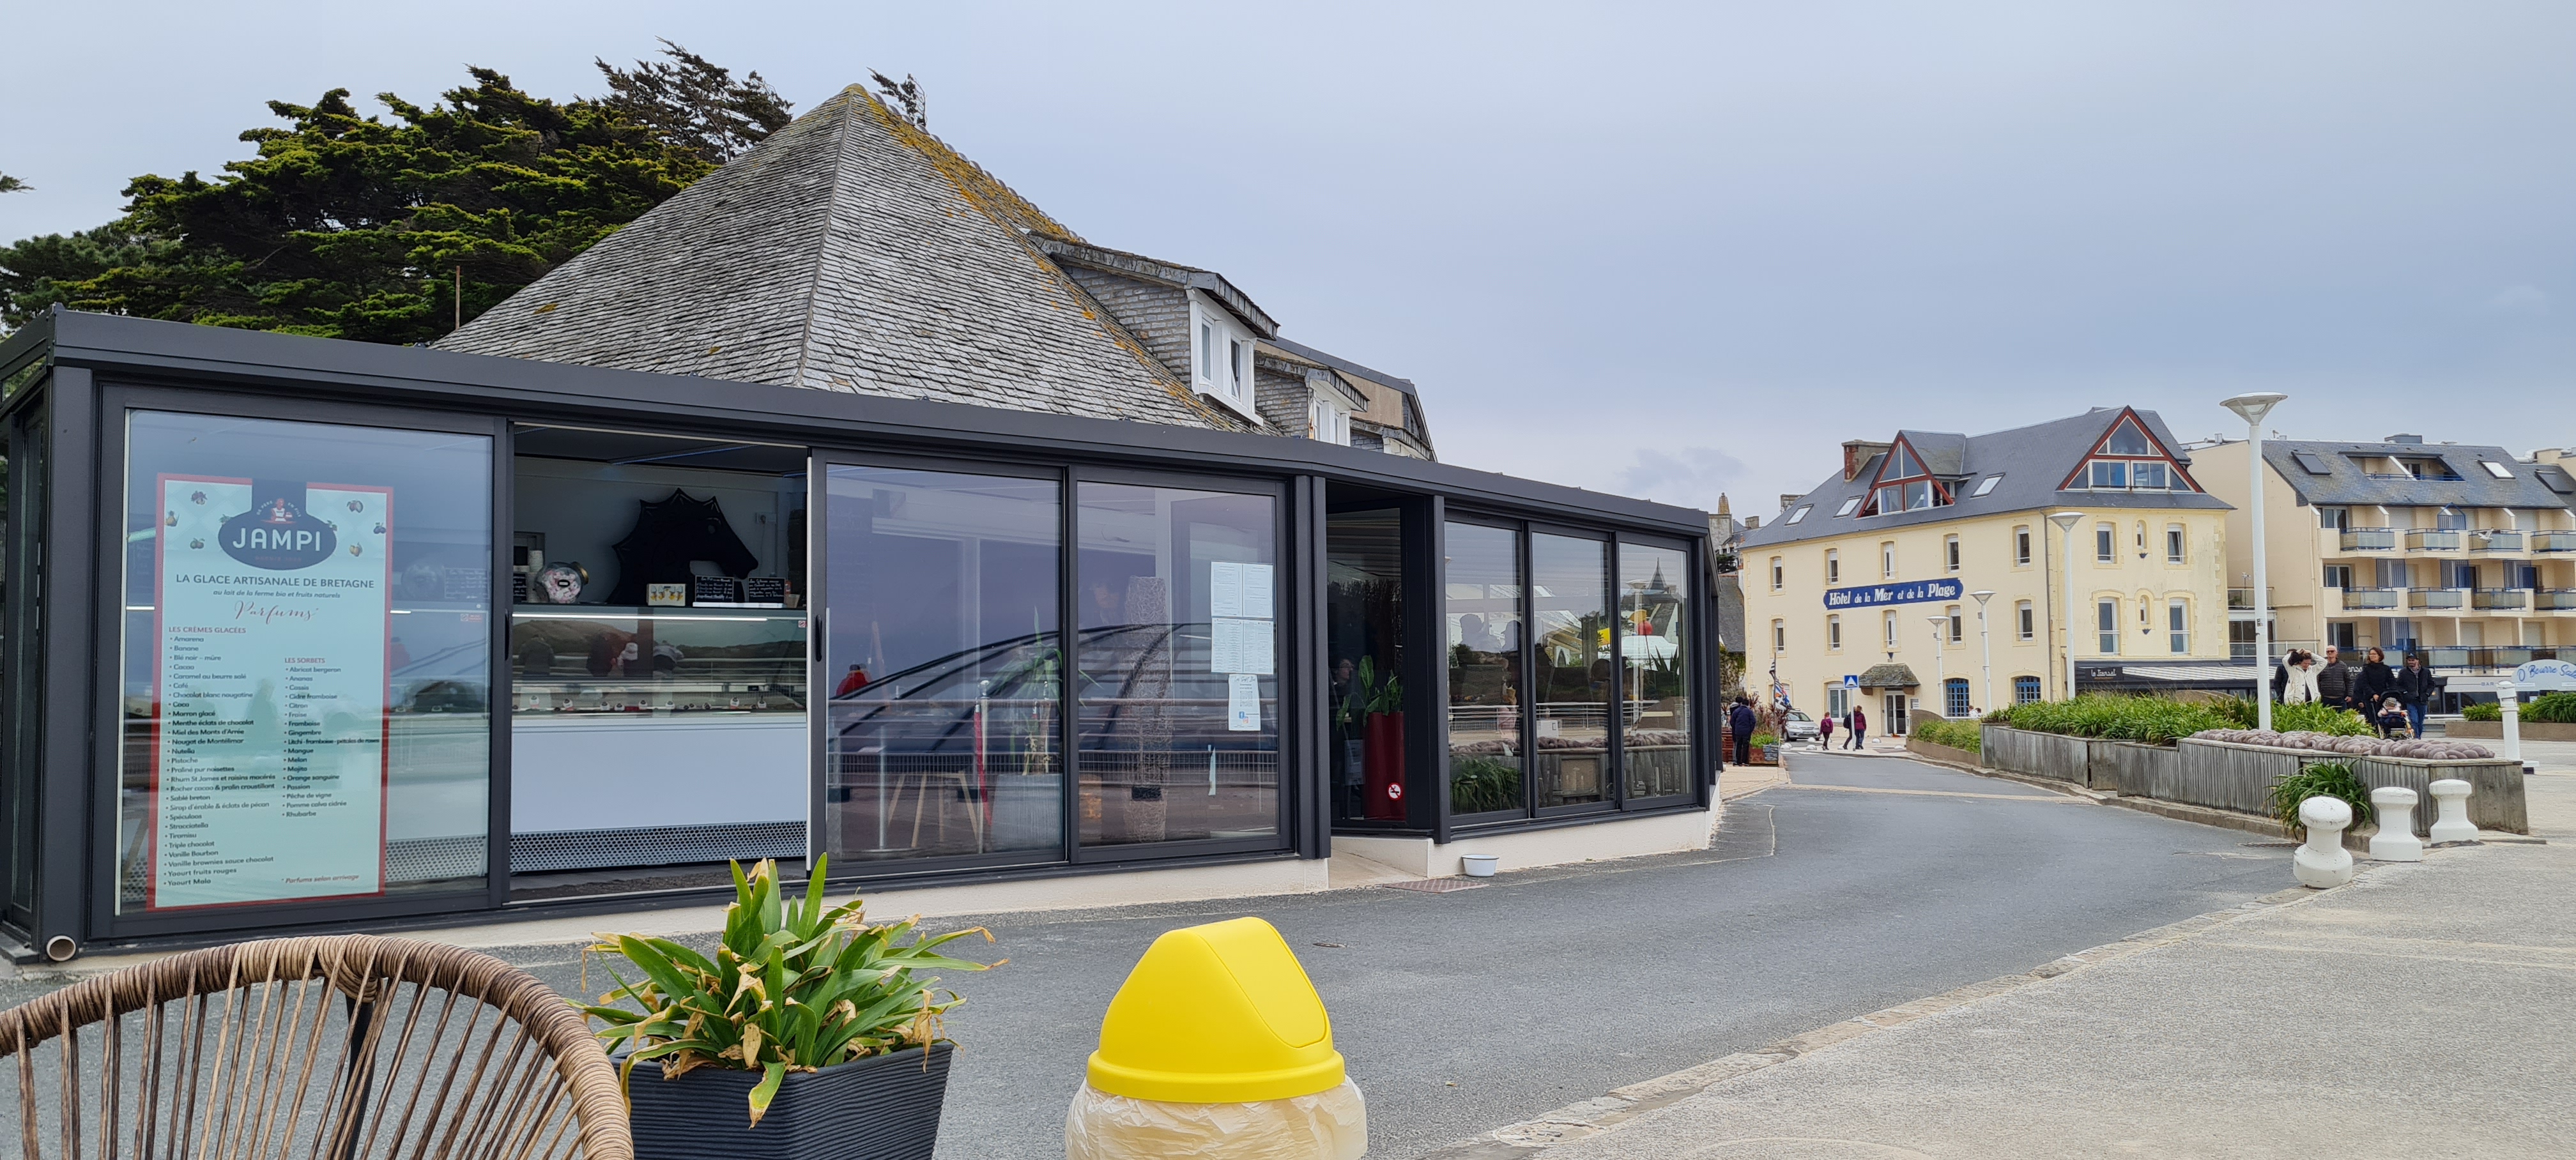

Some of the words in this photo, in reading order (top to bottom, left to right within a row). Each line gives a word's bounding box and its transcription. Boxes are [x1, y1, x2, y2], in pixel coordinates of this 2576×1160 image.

[233, 528, 321, 551] JAMPI
[176, 574, 190, 583] LA
[194, 575, 231, 584] GLACE
[233, 576, 300, 586] ARTISANALE
[303, 578, 318, 587] DE
[320, 579, 374, 588] BRETAGNE
[1829, 590, 1851, 606] Hôtel
[1854, 593, 1862, 604] de
[1864, 592, 1871, 602] la
[1874, 588, 1893, 602] Mer
[1897, 590, 1904, 600] et
[1906, 588, 1915, 599] de
[1917, 586, 1924, 599] la
[1928, 583, 1956, 597] Plage
